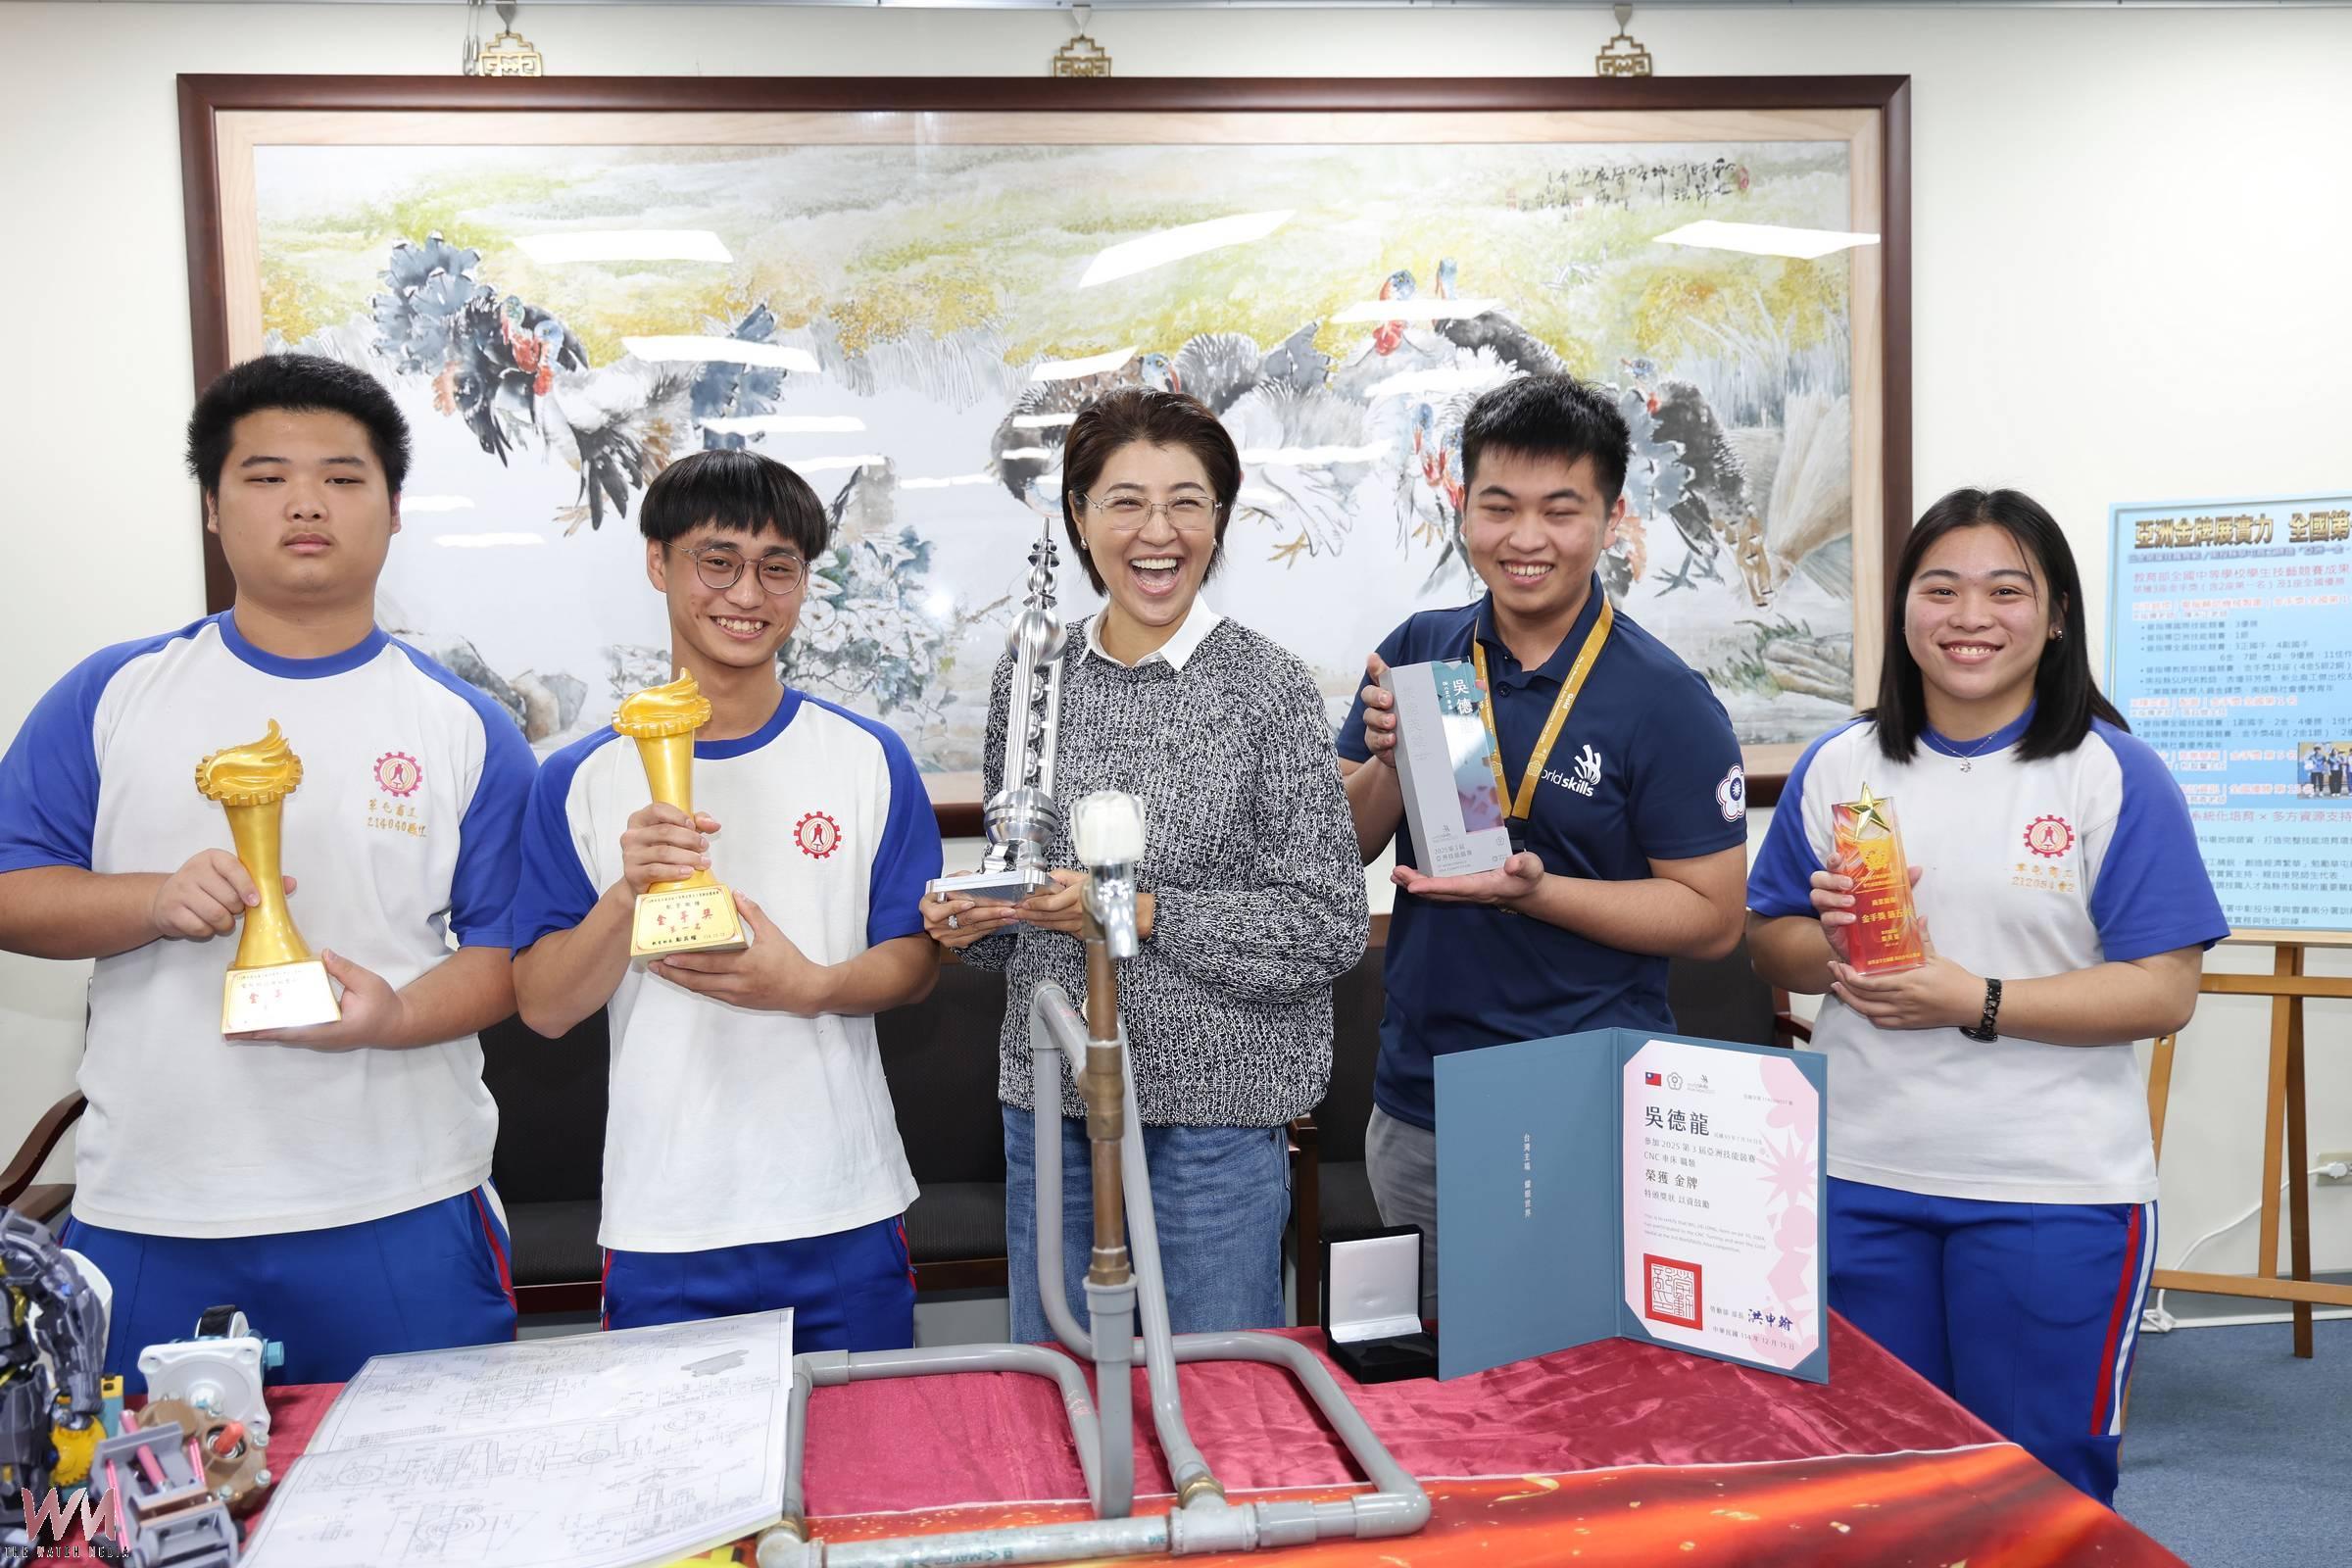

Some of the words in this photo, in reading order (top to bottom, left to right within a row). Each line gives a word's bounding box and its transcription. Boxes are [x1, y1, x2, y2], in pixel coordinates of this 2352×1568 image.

[2134, 514, 2274, 549] 亞洲金牌展實力
[2288, 510, 2351, 543] 全國第
[1452, 679, 1473, 716] 吳德
[1541, 768, 1594, 798] orldskills
[1644, 1105, 1710, 1137] 吳德龍
[1643, 1152, 1660, 1161] CNC
[1661, 1141, 1681, 1151] 2025
[1645, 1168, 1669, 1185] 榮獲
[1675, 1173, 1699, 1190] 金牌
